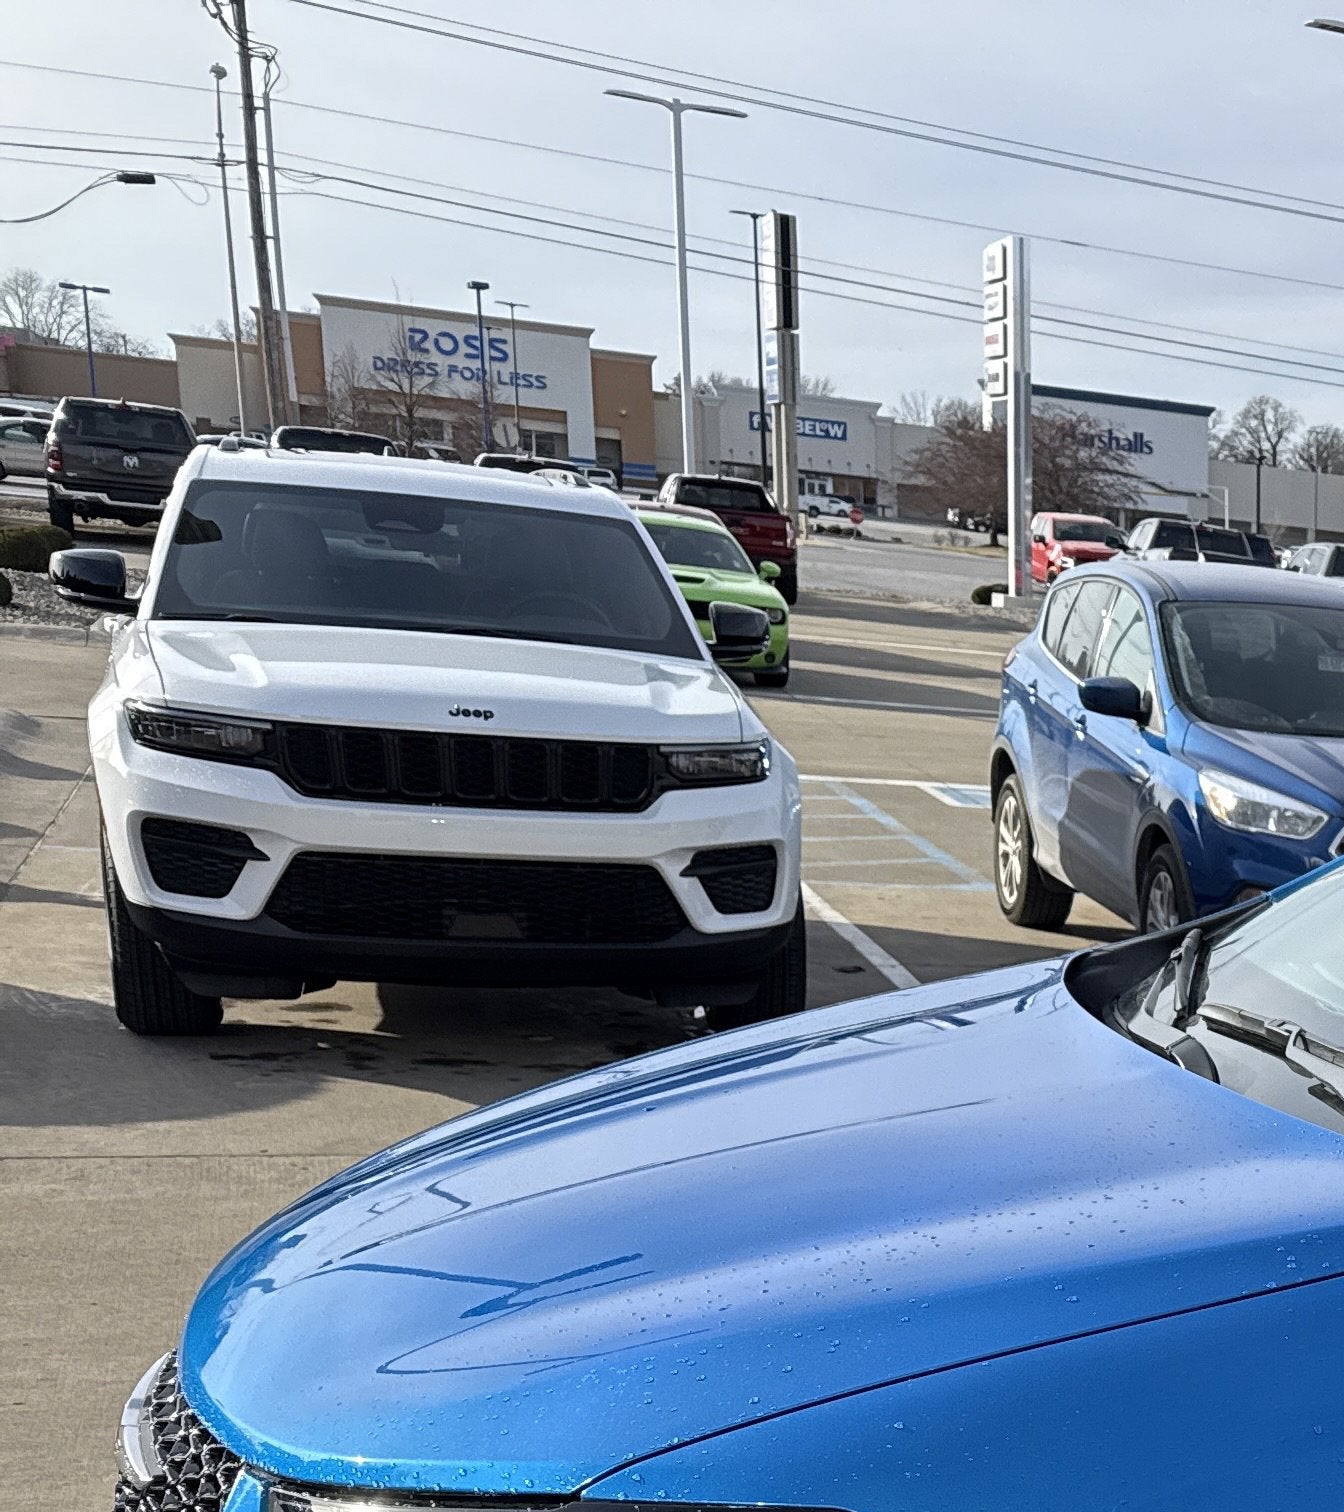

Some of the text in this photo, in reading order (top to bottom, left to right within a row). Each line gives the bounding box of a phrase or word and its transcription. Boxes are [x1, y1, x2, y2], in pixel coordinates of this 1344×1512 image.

[408, 328, 509, 362] ROSS
[448, 364, 487, 382] FOR
[497, 370, 547, 389] LESS
[448, 704, 494, 721] Jeep
